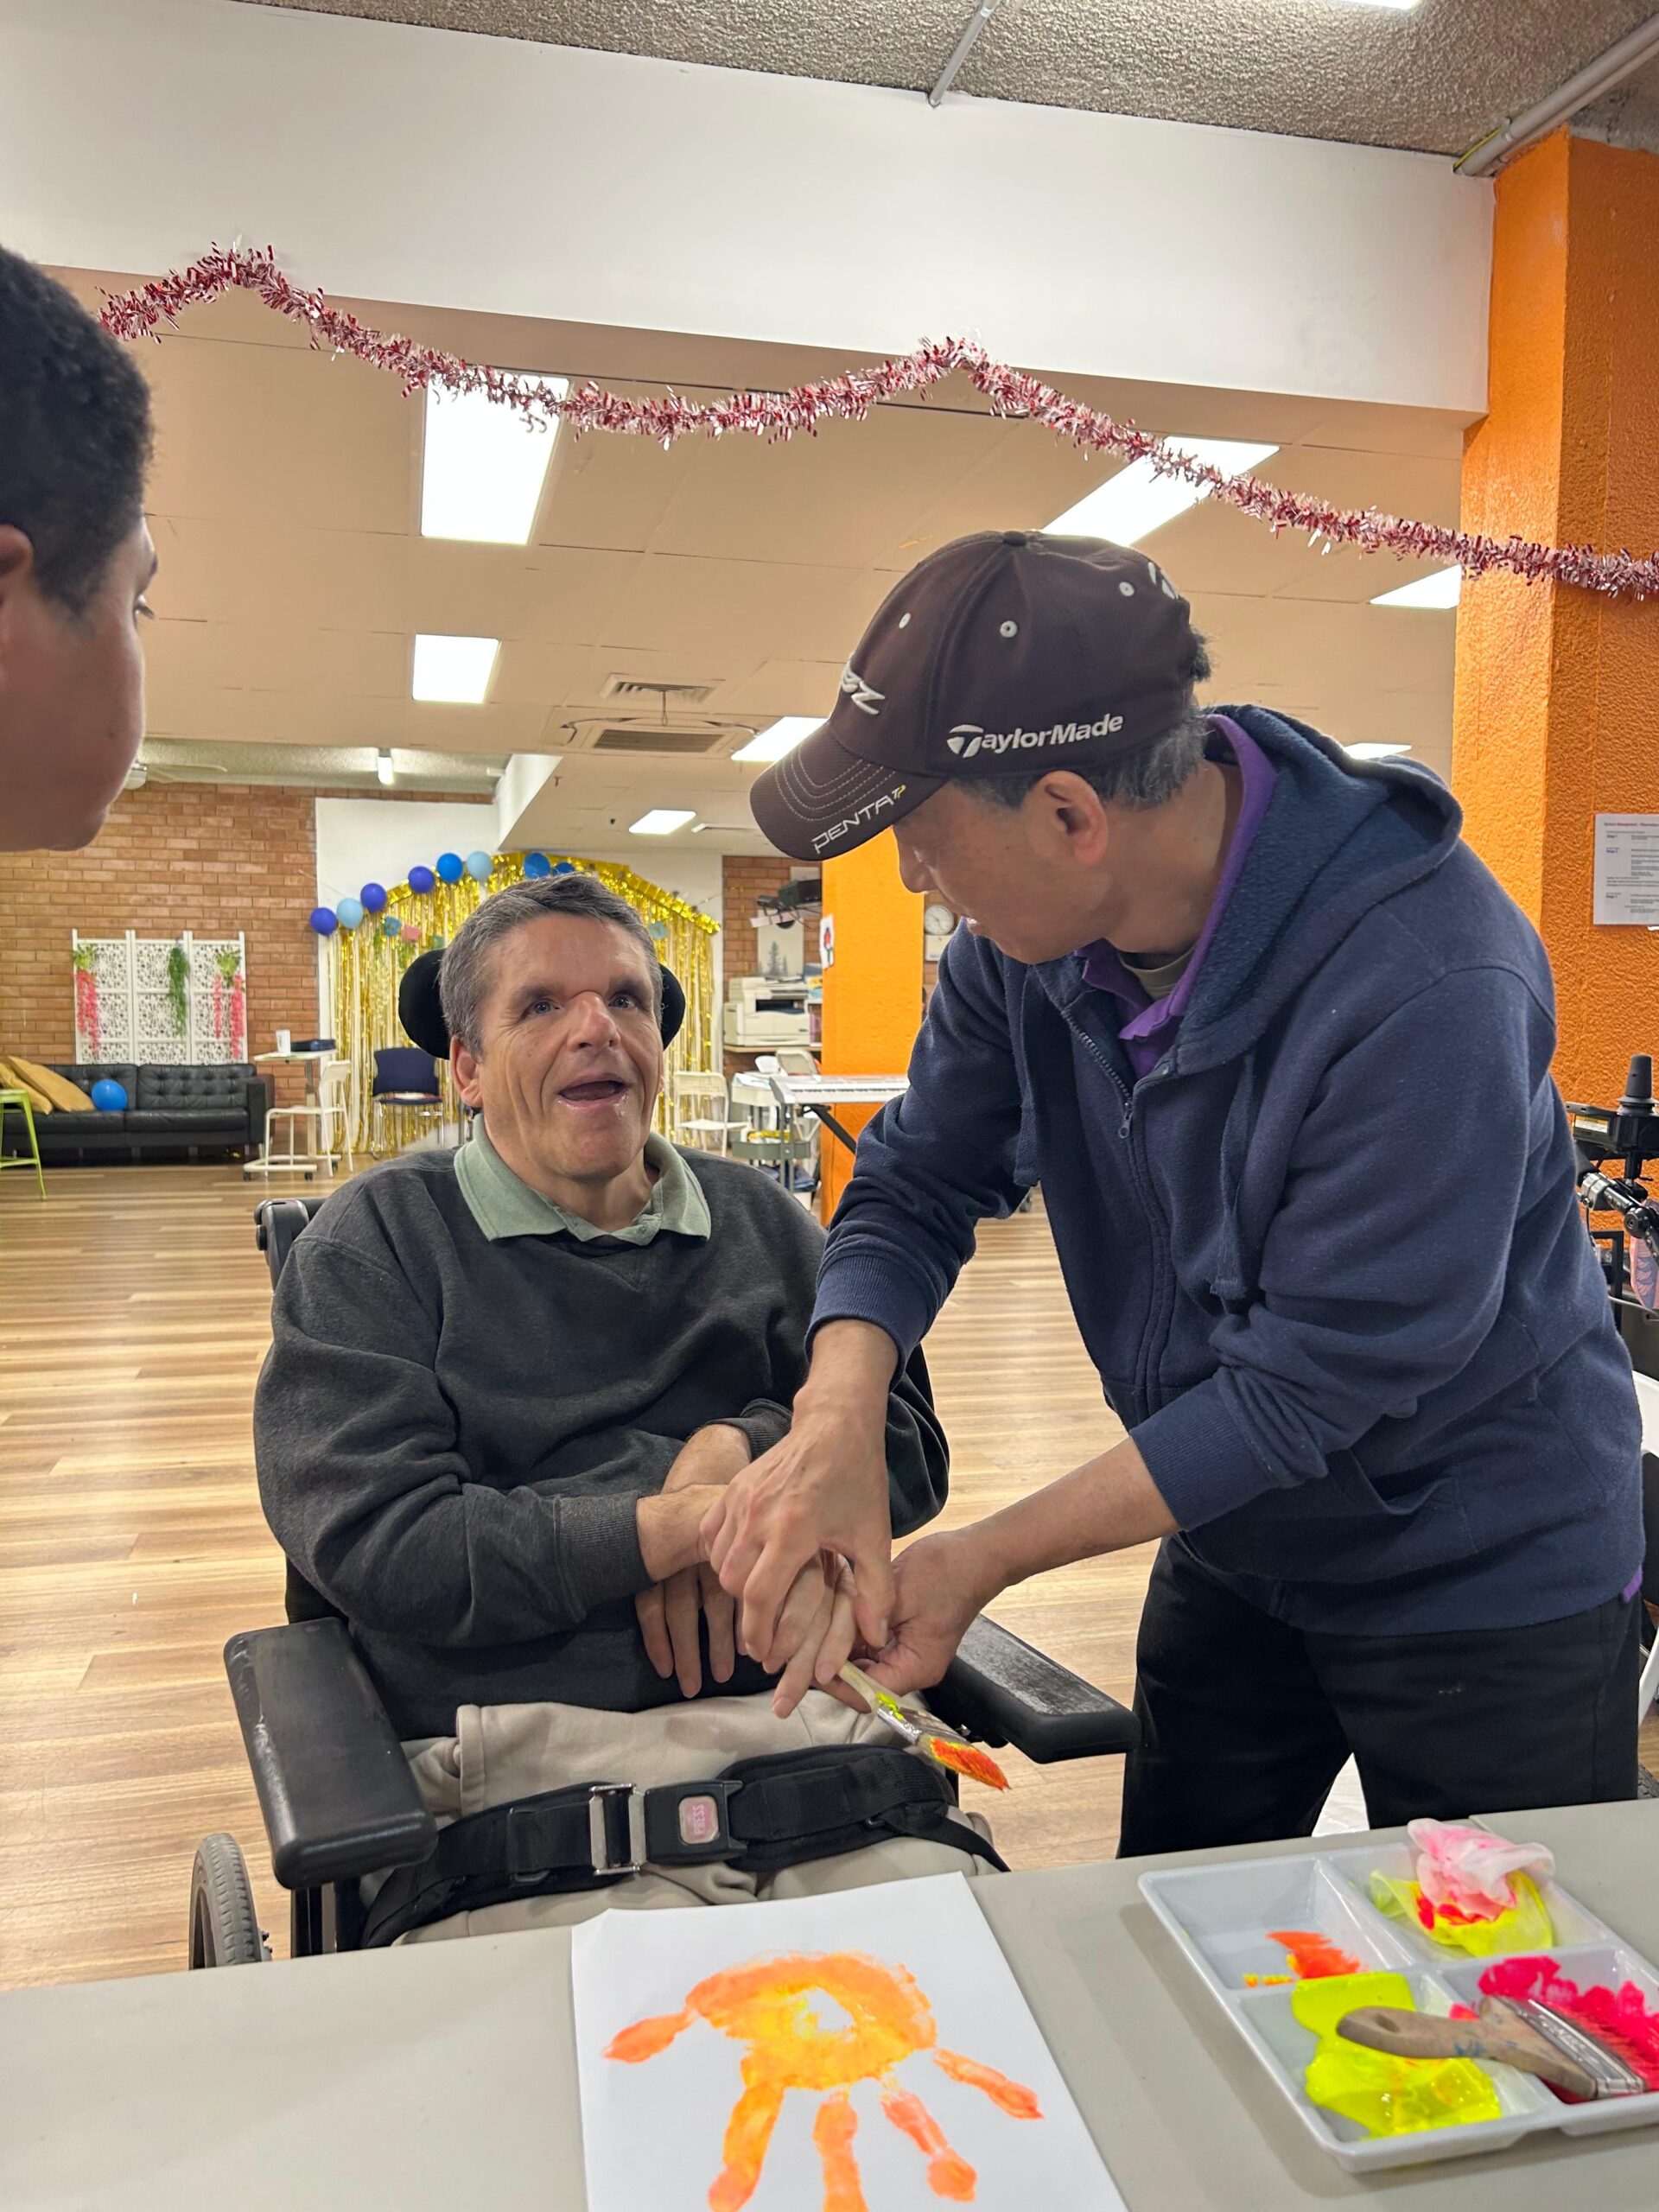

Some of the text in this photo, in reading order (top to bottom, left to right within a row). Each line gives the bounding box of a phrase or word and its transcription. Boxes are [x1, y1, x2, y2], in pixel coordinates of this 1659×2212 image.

[947, 713, 1123, 759] TaylorMade
[811, 794, 894, 854] PENTA
[692, 1803, 705, 1835] PRESS
